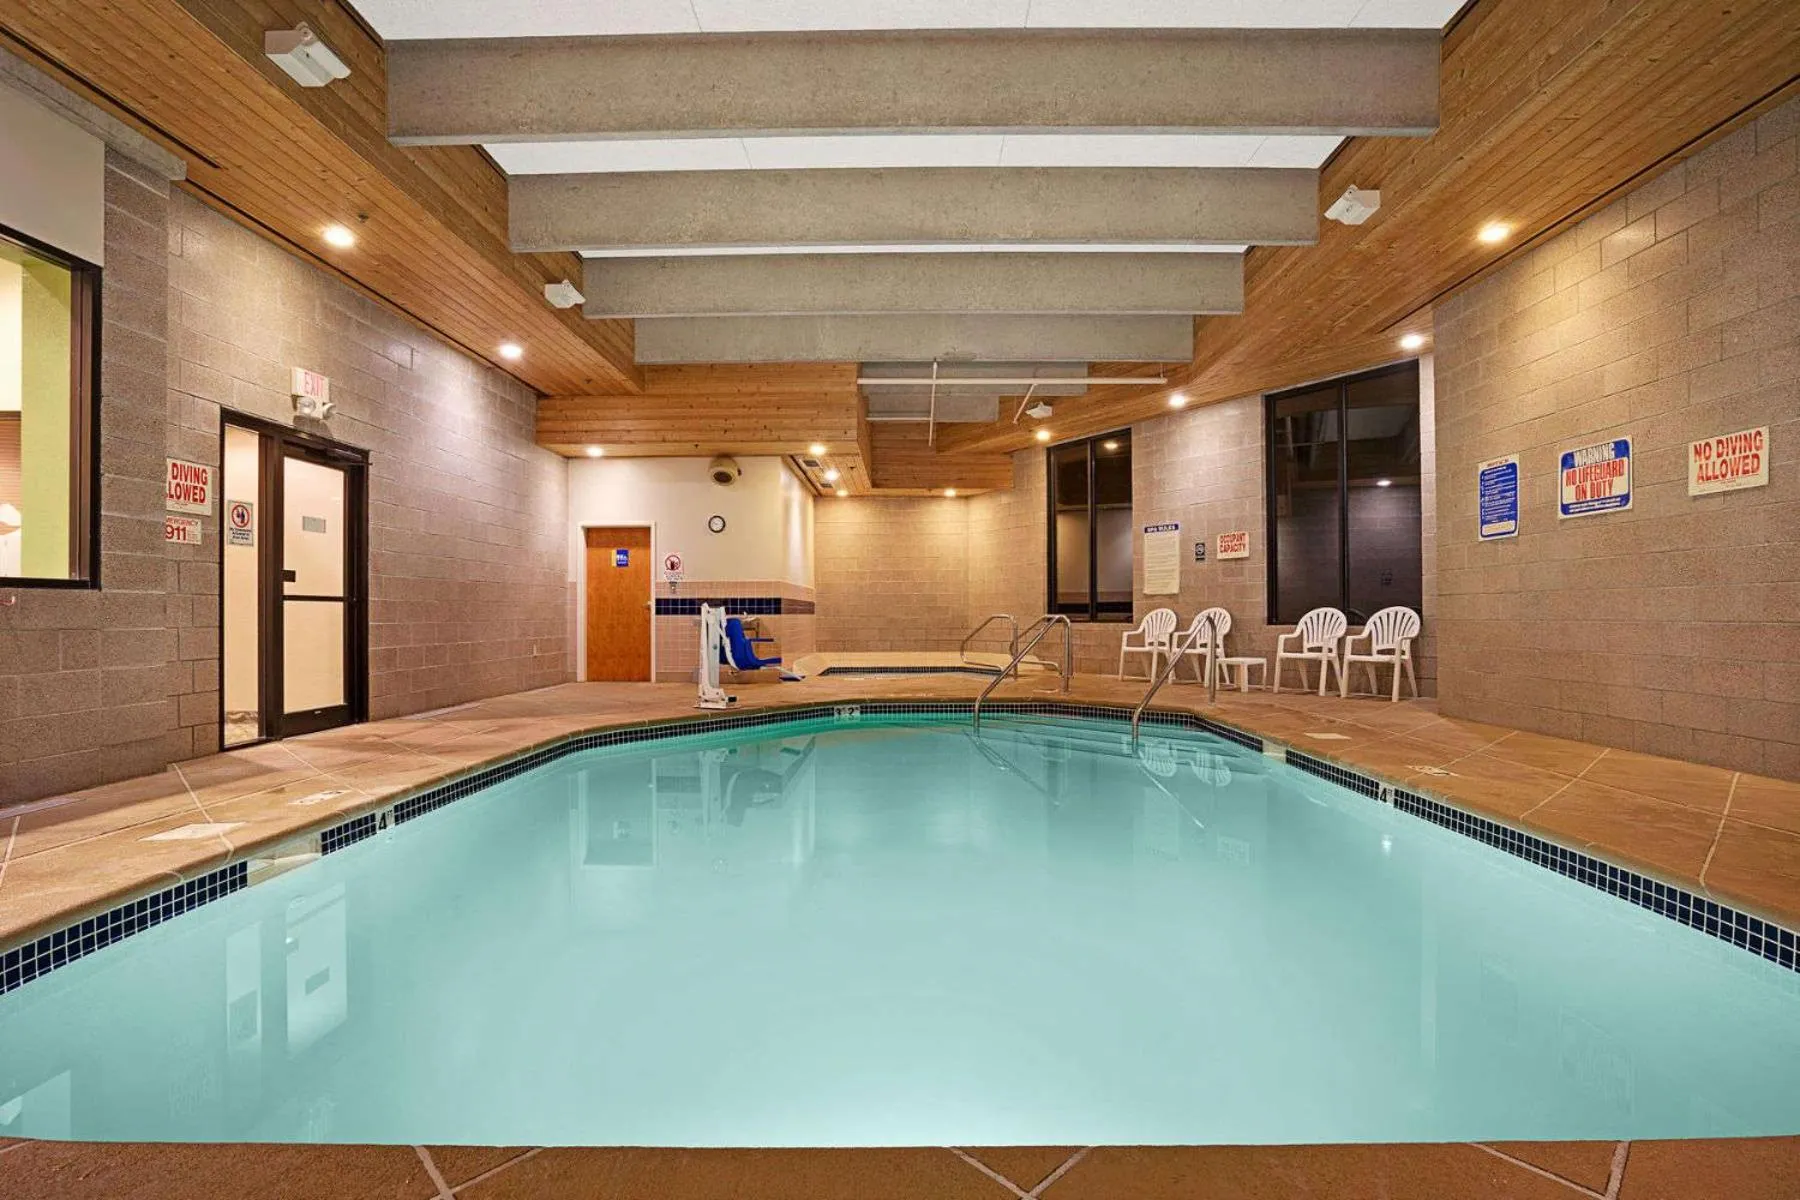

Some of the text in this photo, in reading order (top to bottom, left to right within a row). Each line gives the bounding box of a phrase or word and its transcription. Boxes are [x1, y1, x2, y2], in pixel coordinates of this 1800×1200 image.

[304, 371, 325, 396] EXIT
[1573, 442, 1615, 468] WARNING
[1693, 430, 1763, 463] NO DIVING
[171, 462, 208, 486] DIVING
[1566, 459, 1625, 487] NO LIFEGUARD
[1697, 453, 1761, 483] ALLOWED
[166, 481, 206, 504] LOWED
[1576, 478, 1614, 501] ON DUTY
[165, 525, 187, 540] 911
[1219, 543, 1246, 553] CAPACITY
[1380, 787, 1387, 803] 4
[378, 812, 387, 830] 4
